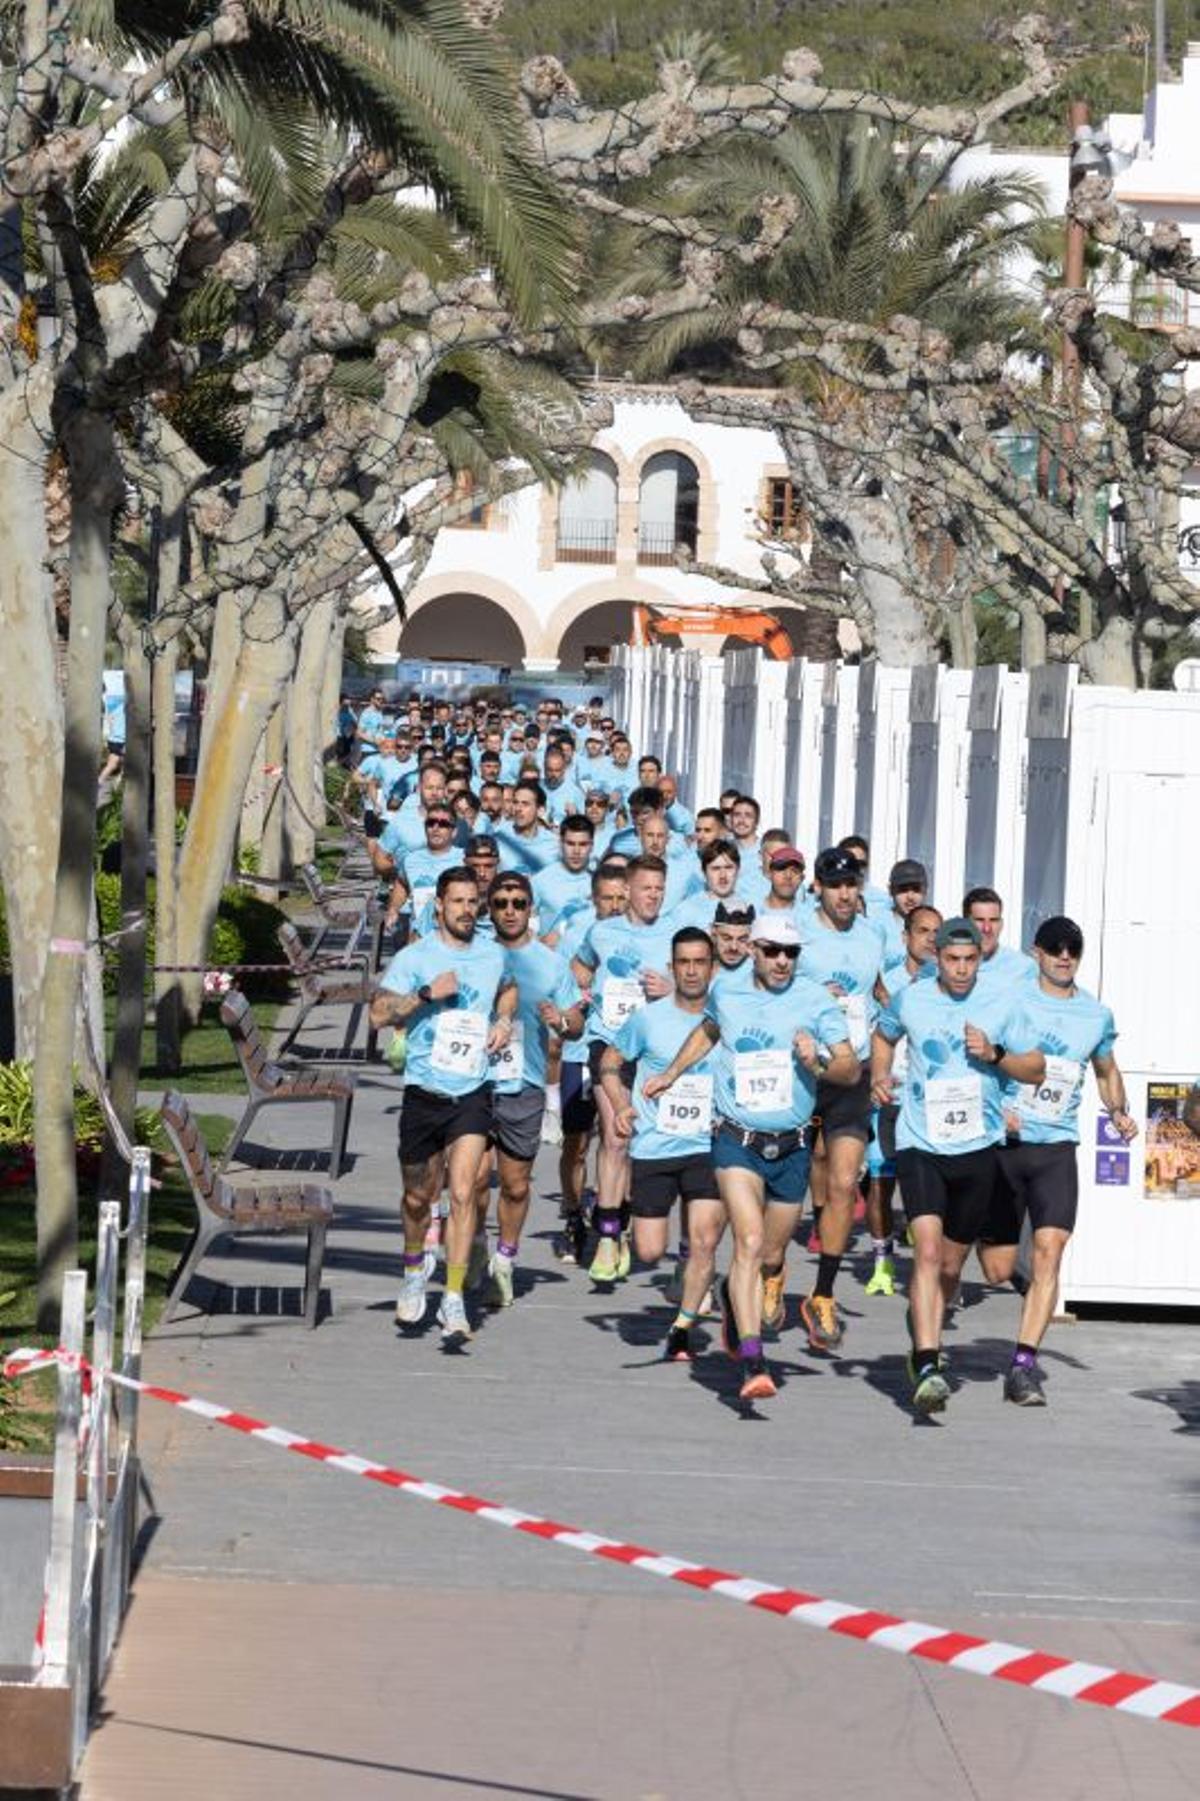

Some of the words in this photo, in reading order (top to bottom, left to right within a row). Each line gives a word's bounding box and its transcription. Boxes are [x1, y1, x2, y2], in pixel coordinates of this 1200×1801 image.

[450, 1041, 472, 1056] 97
[748, 1077, 779, 1094] 157
[669, 1104, 701, 1119] 109
[944, 1110, 968, 1125] 42
